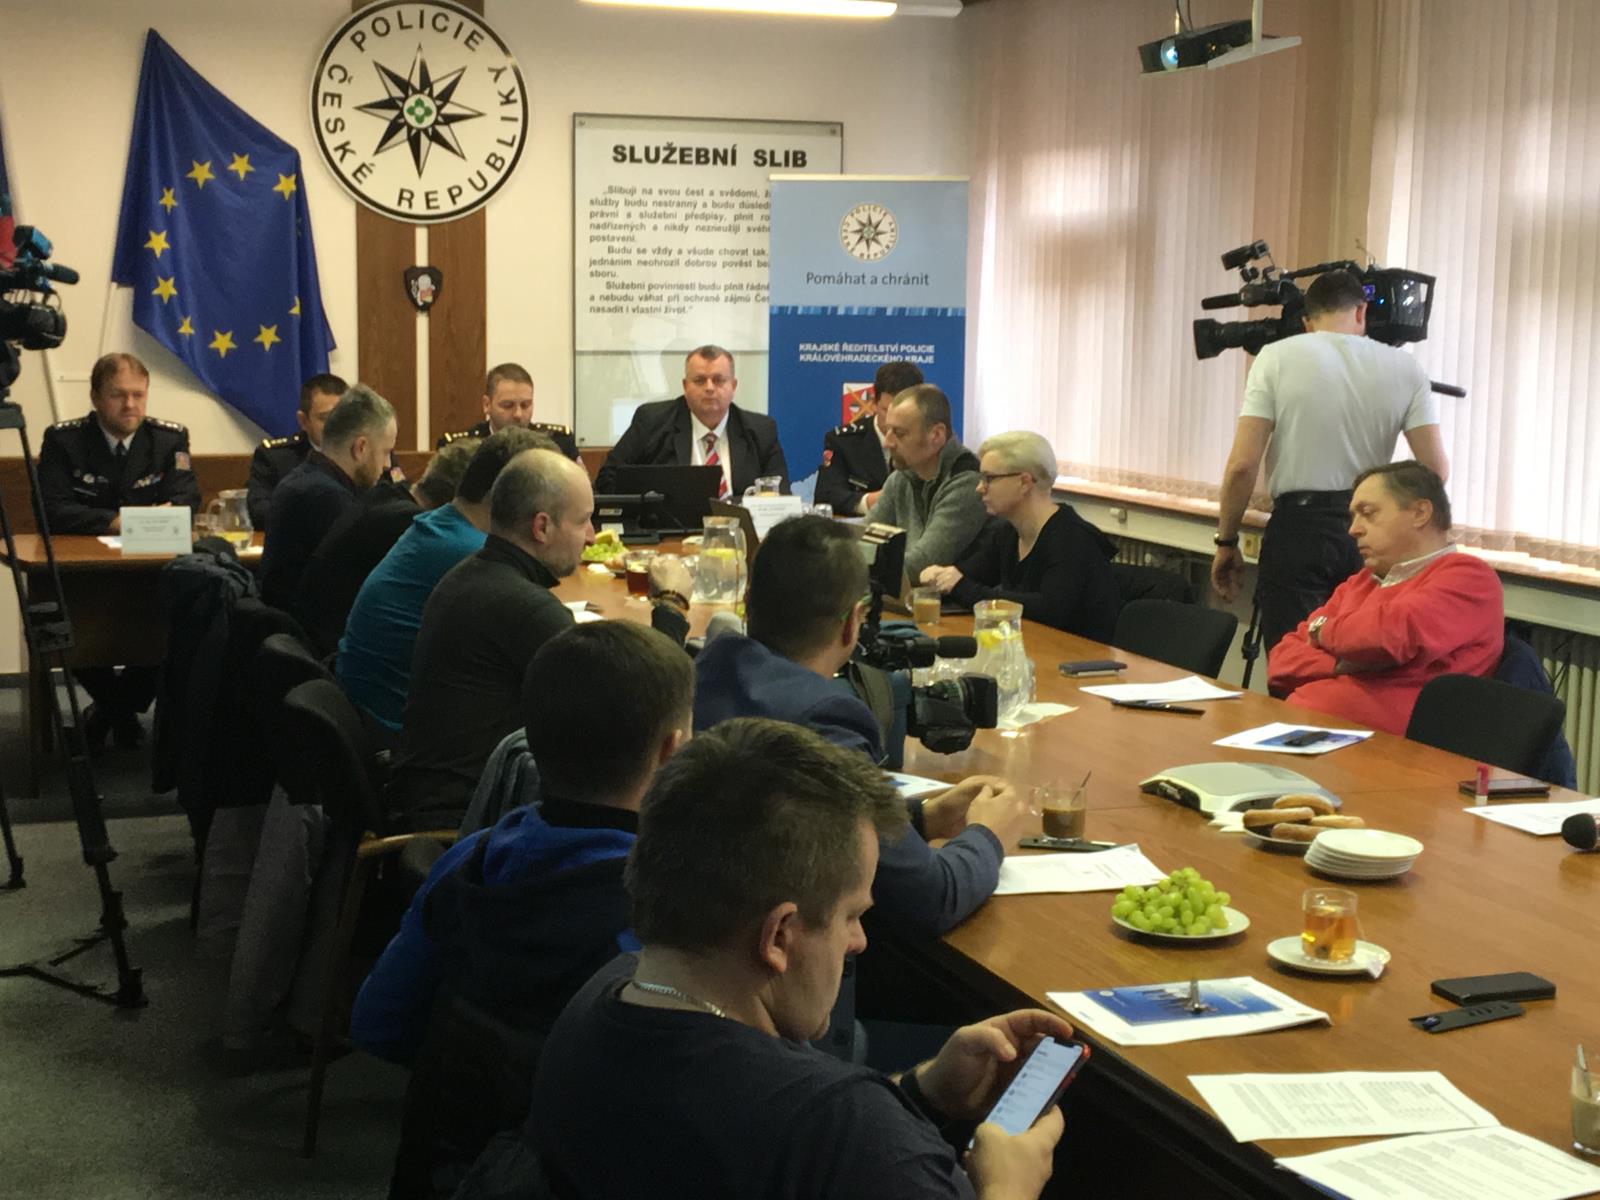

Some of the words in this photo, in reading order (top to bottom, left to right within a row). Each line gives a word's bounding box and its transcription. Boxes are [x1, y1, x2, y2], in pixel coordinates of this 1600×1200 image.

[350, 9, 485, 52] POLICIE
[322, 64, 376, 185] ČESKÉ
[397, 65, 519, 210] REPUBLIKY
[612, 141, 738, 167] SLUŽEBNÍ
[753, 148, 808, 169] SLIB
[642, 188, 653, 196] na
[658, 188, 681, 197] svou
[709, 189, 714, 197] a
[589, 197, 620, 208] služby
[624, 198, 648, 207] budu
[702, 201, 708, 209] a
[711, 200, 735, 209] budu
[626, 211, 632, 219] a
[734, 212, 754, 222] plnit
[664, 223, 689, 234] nikdy
[607, 245, 632, 255] Budu
[636, 247, 647, 255] se
[651, 246, 673, 257] vždy
[677, 247, 683, 255] a
[687, 246, 715, 256] všude
[718, 247, 749, 257] chovat
[589, 257, 632, 268] jednáním
[637, 258, 680, 267] neohrozil
[684, 259, 718, 268] dobrou
[722, 259, 752, 269] pověst
[806, 272, 866, 285] Pomáhat
[870, 275, 878, 285] a
[881, 273, 930, 286] chránit
[605, 281, 646, 290] Služební
[698, 282, 721, 291] budu
[723, 282, 744, 292] plnit
[589, 294, 595, 302] a
[599, 293, 634, 302] nebudu
[638, 293, 663, 302] váhat
[589, 305, 624, 314] nasadit
[631, 305, 662, 314] vlastní
[798, 342, 840, 352] KRAJSKÉ
[841, 342, 899, 353] ŘEDITELSTVÍ
[900, 344, 935, 353] POLICIE
[799, 353, 904, 363] KRÁLOVÉHRADECKÉHO
[905, 355, 935, 364] KRAJE
